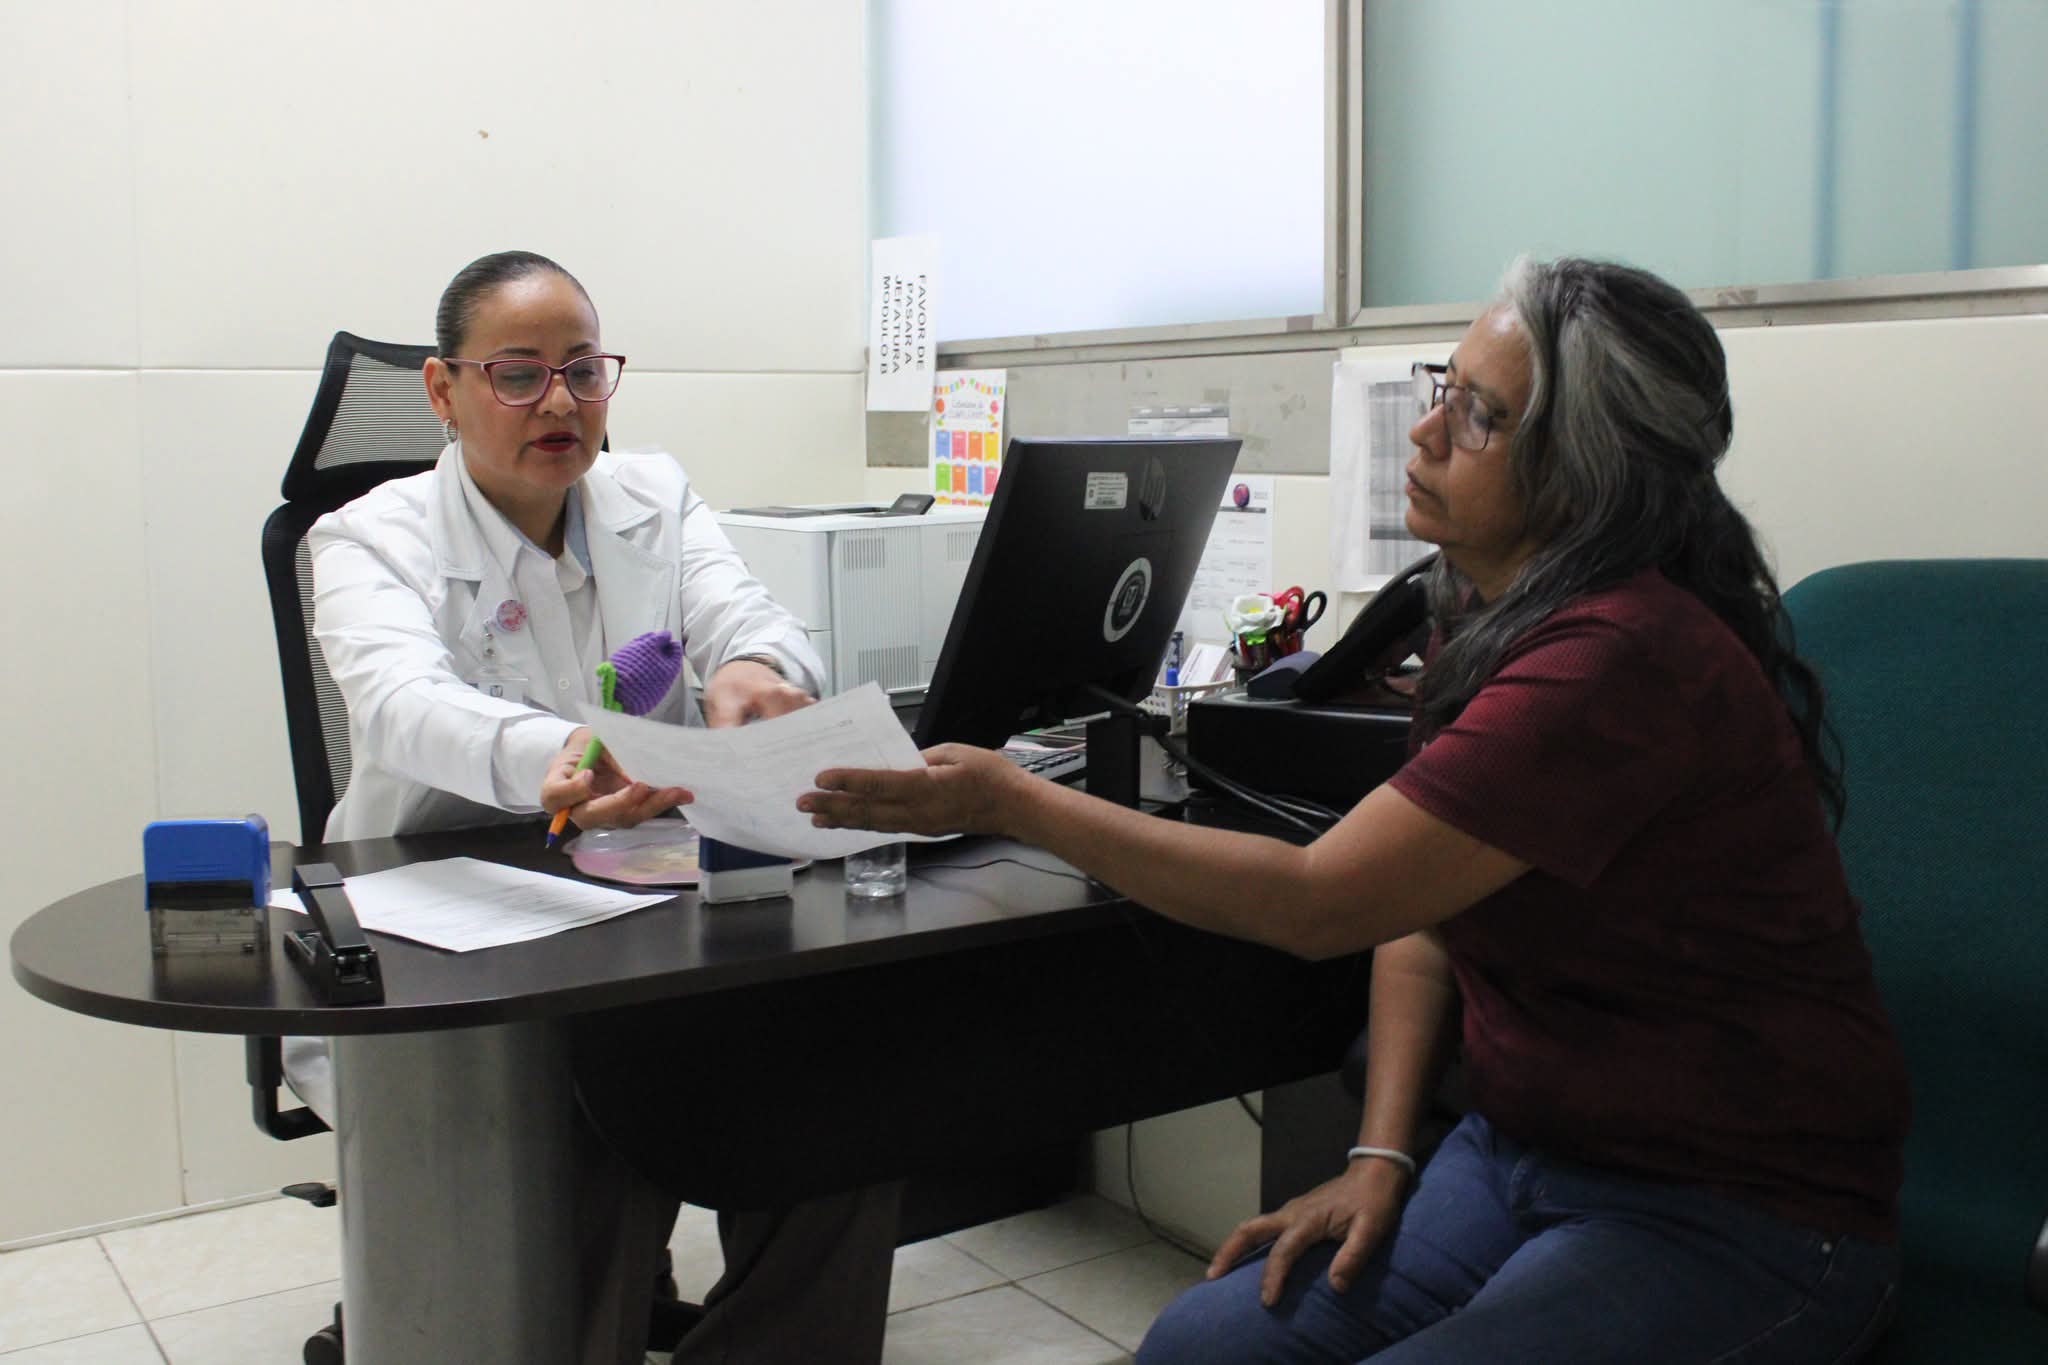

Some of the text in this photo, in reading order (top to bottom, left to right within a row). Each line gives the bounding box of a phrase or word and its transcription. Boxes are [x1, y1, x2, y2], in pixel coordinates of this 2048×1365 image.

[881, 276, 891, 375] MODULO B
[892, 275, 902, 374] JEFATURA
[904, 283, 914, 365] PASAR A
[917, 274, 927, 371] FAVOR DE
